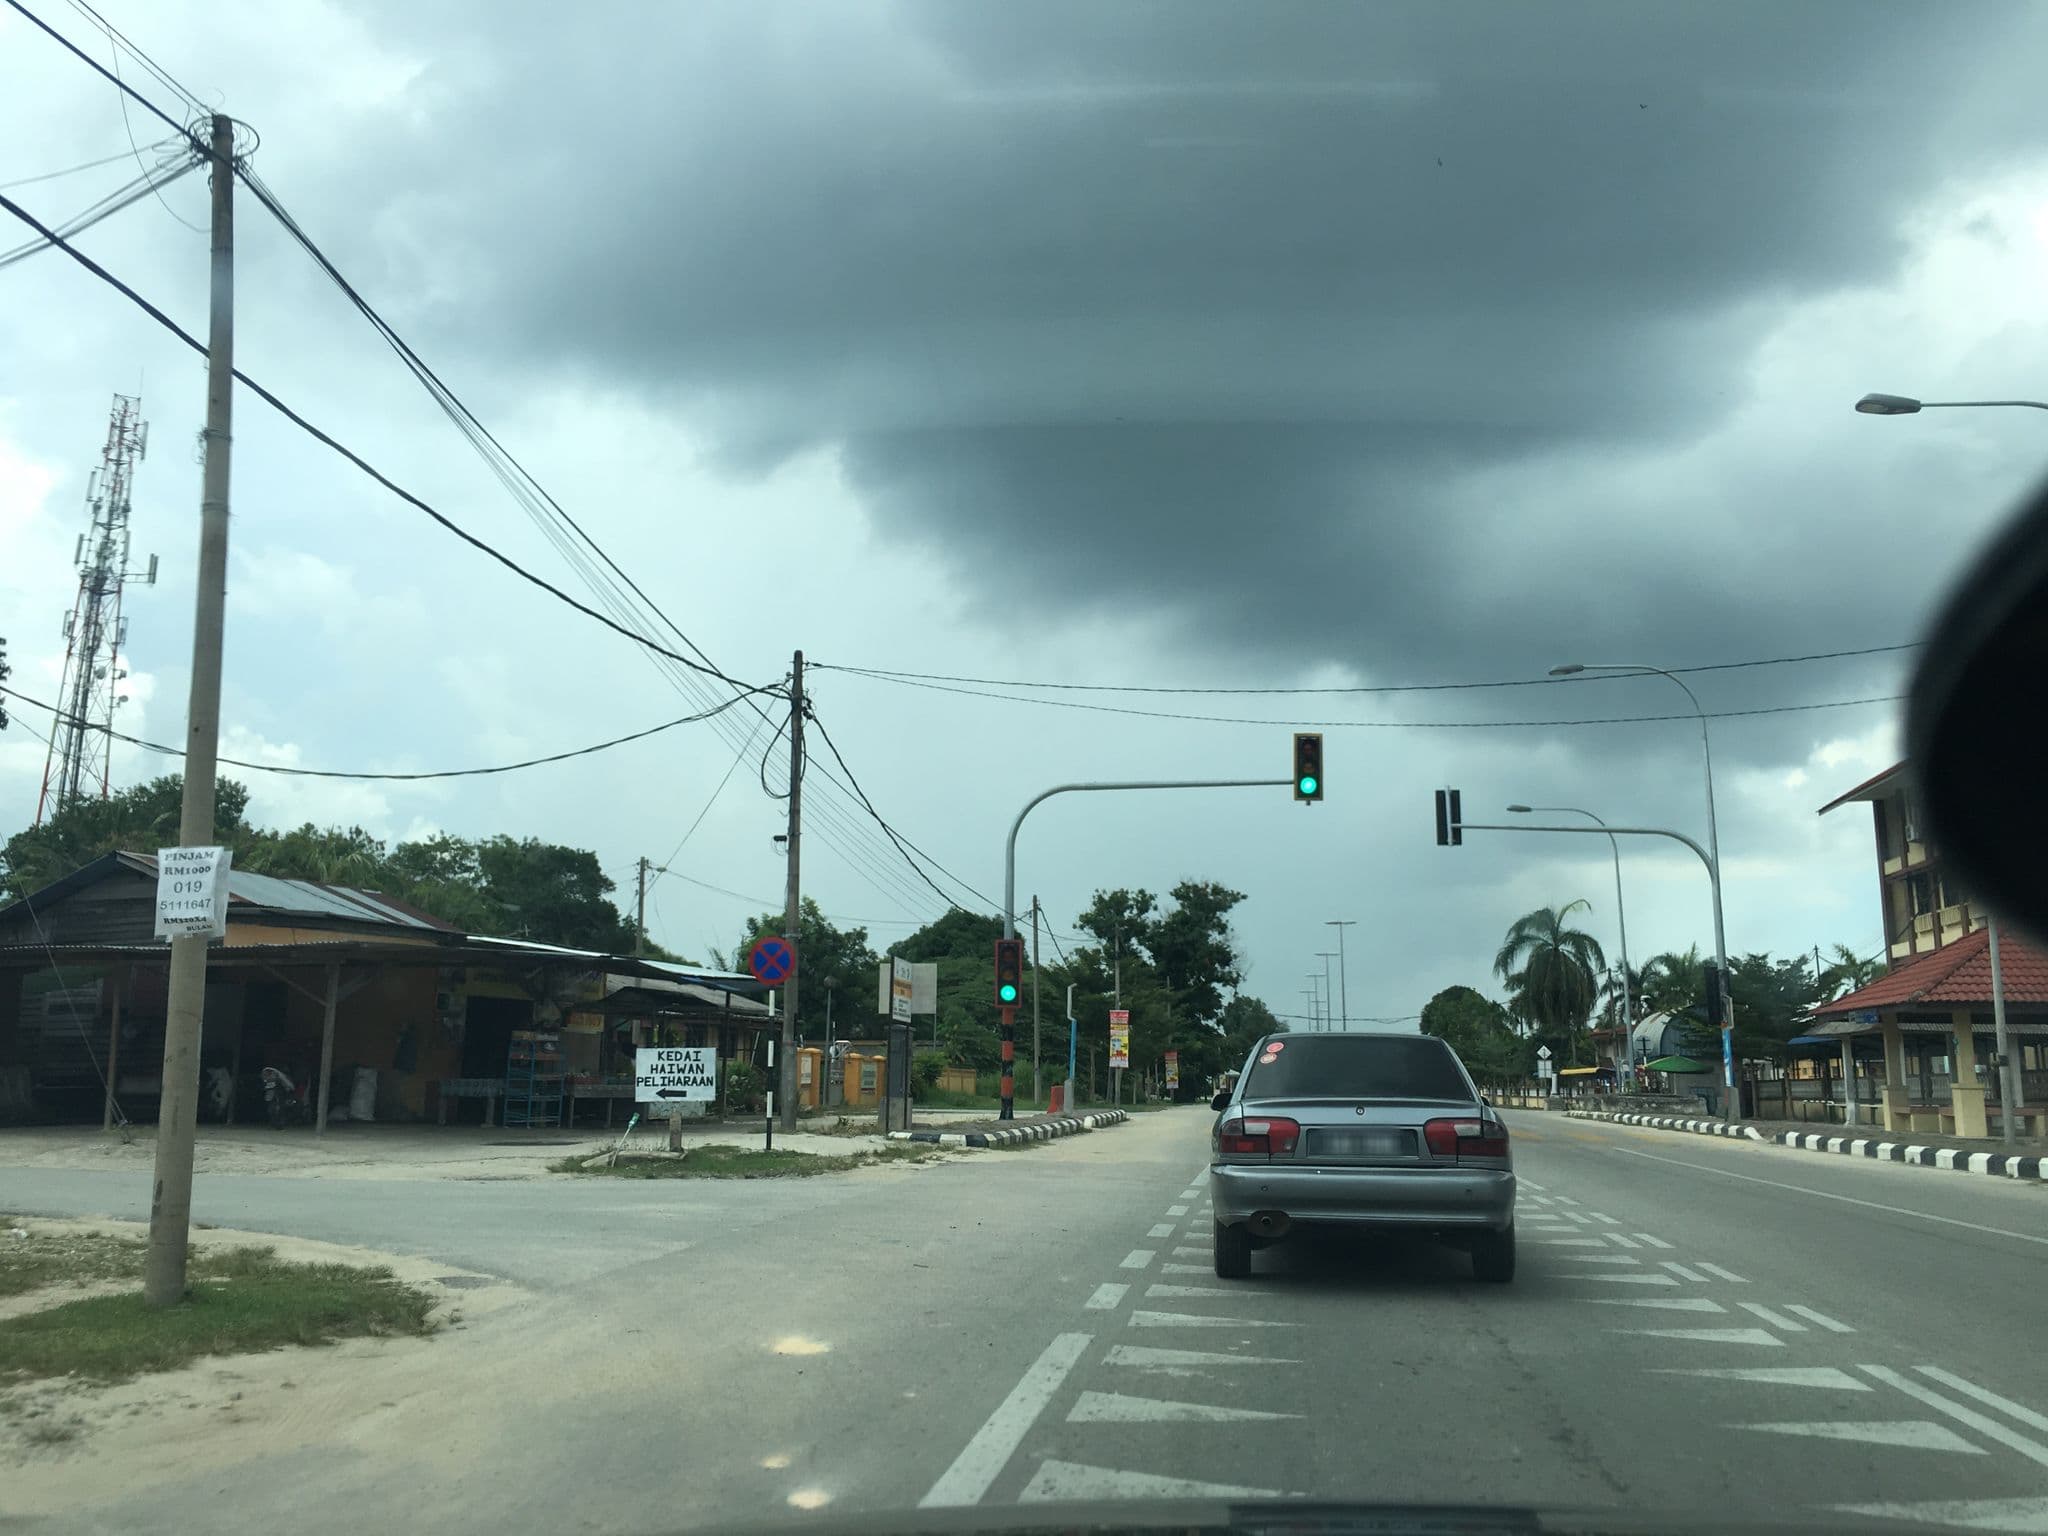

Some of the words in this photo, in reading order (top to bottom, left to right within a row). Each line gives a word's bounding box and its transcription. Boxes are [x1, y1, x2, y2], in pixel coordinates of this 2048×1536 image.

[165, 851, 215, 861] PINJAM
[164, 866, 211, 875] RM1000
[174, 881, 202, 893] 019
[160, 899, 211, 910] 5111647
[657, 1051, 701, 1061] KEDAI
[651, 1064, 704, 1074] HAIWAN
[637, 1077, 713, 1087] PELIHARAAN
